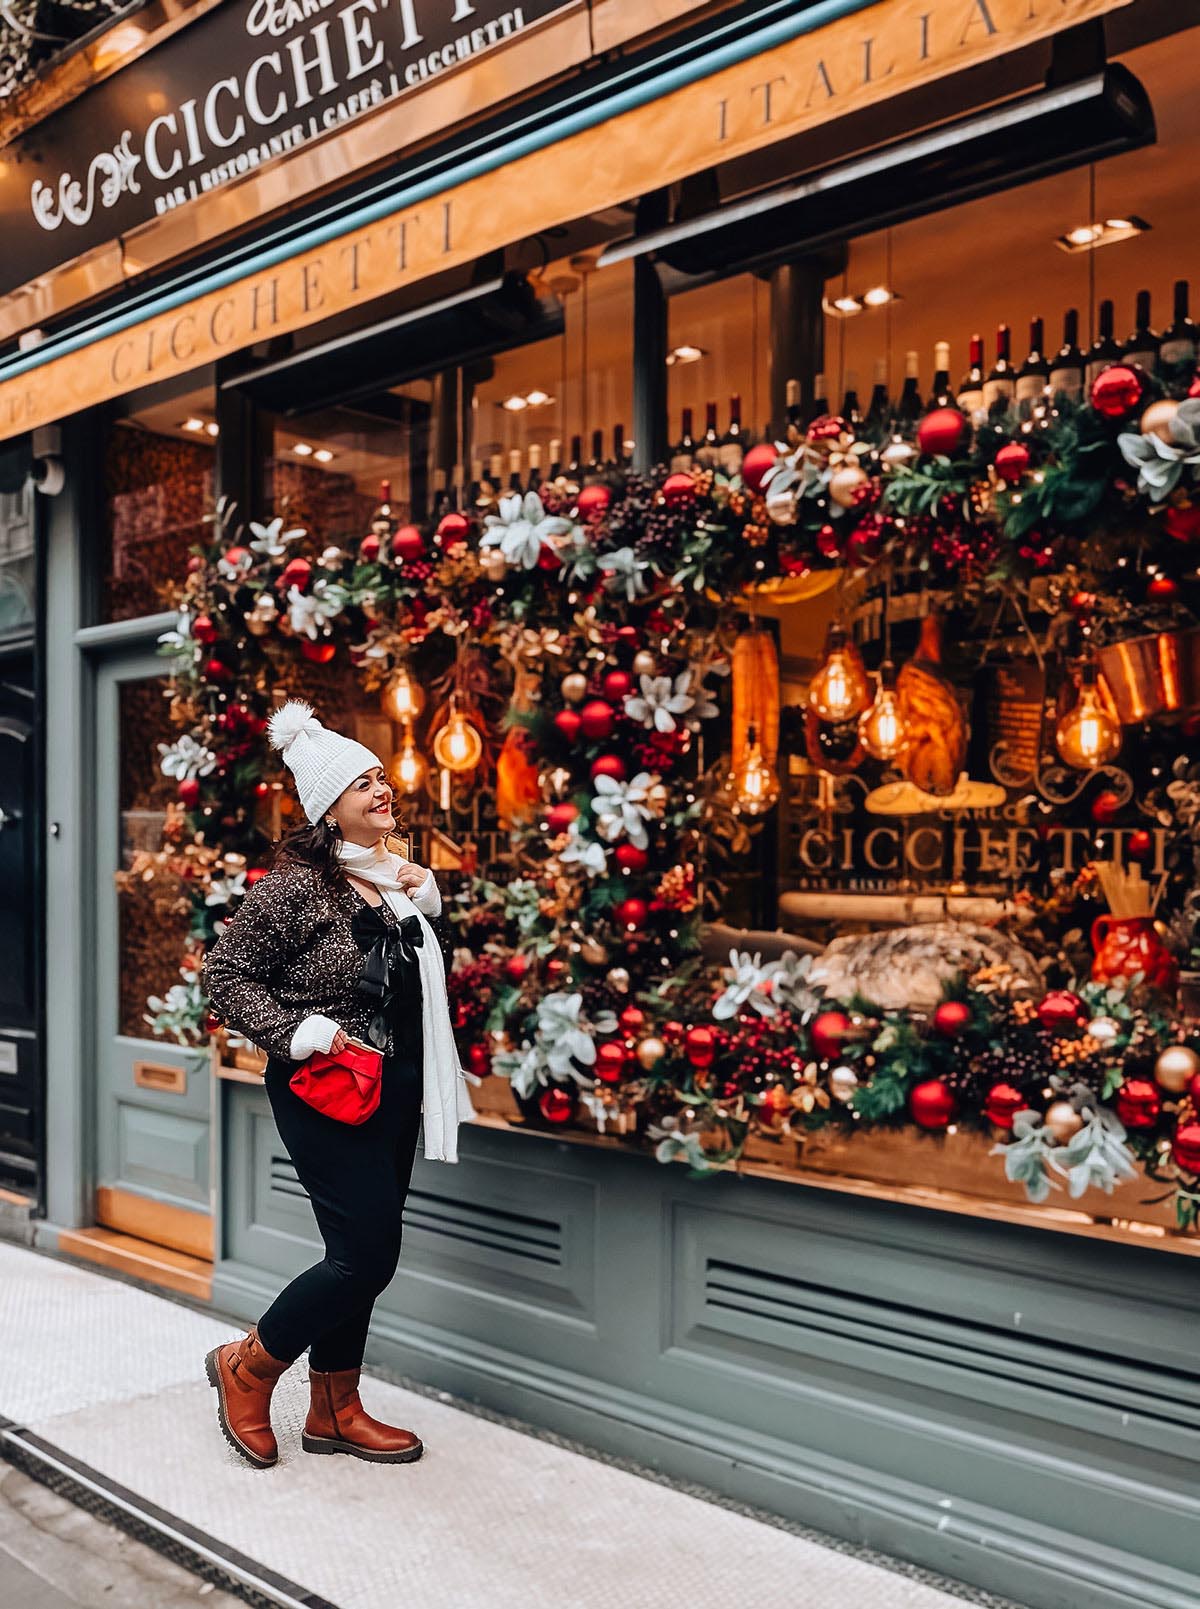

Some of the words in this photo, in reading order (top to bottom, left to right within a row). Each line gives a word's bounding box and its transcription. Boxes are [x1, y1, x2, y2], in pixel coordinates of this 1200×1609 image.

[111, 202, 455, 386] CICCHETTI
[714, 0, 1067, 142] ITALIA
[154, 186, 188, 216] BAR
[200, 123, 306, 192] RISTORANTE
[404, 7, 525, 86] CICCHETTI
[800, 827, 1169, 874] CICCHETTI
